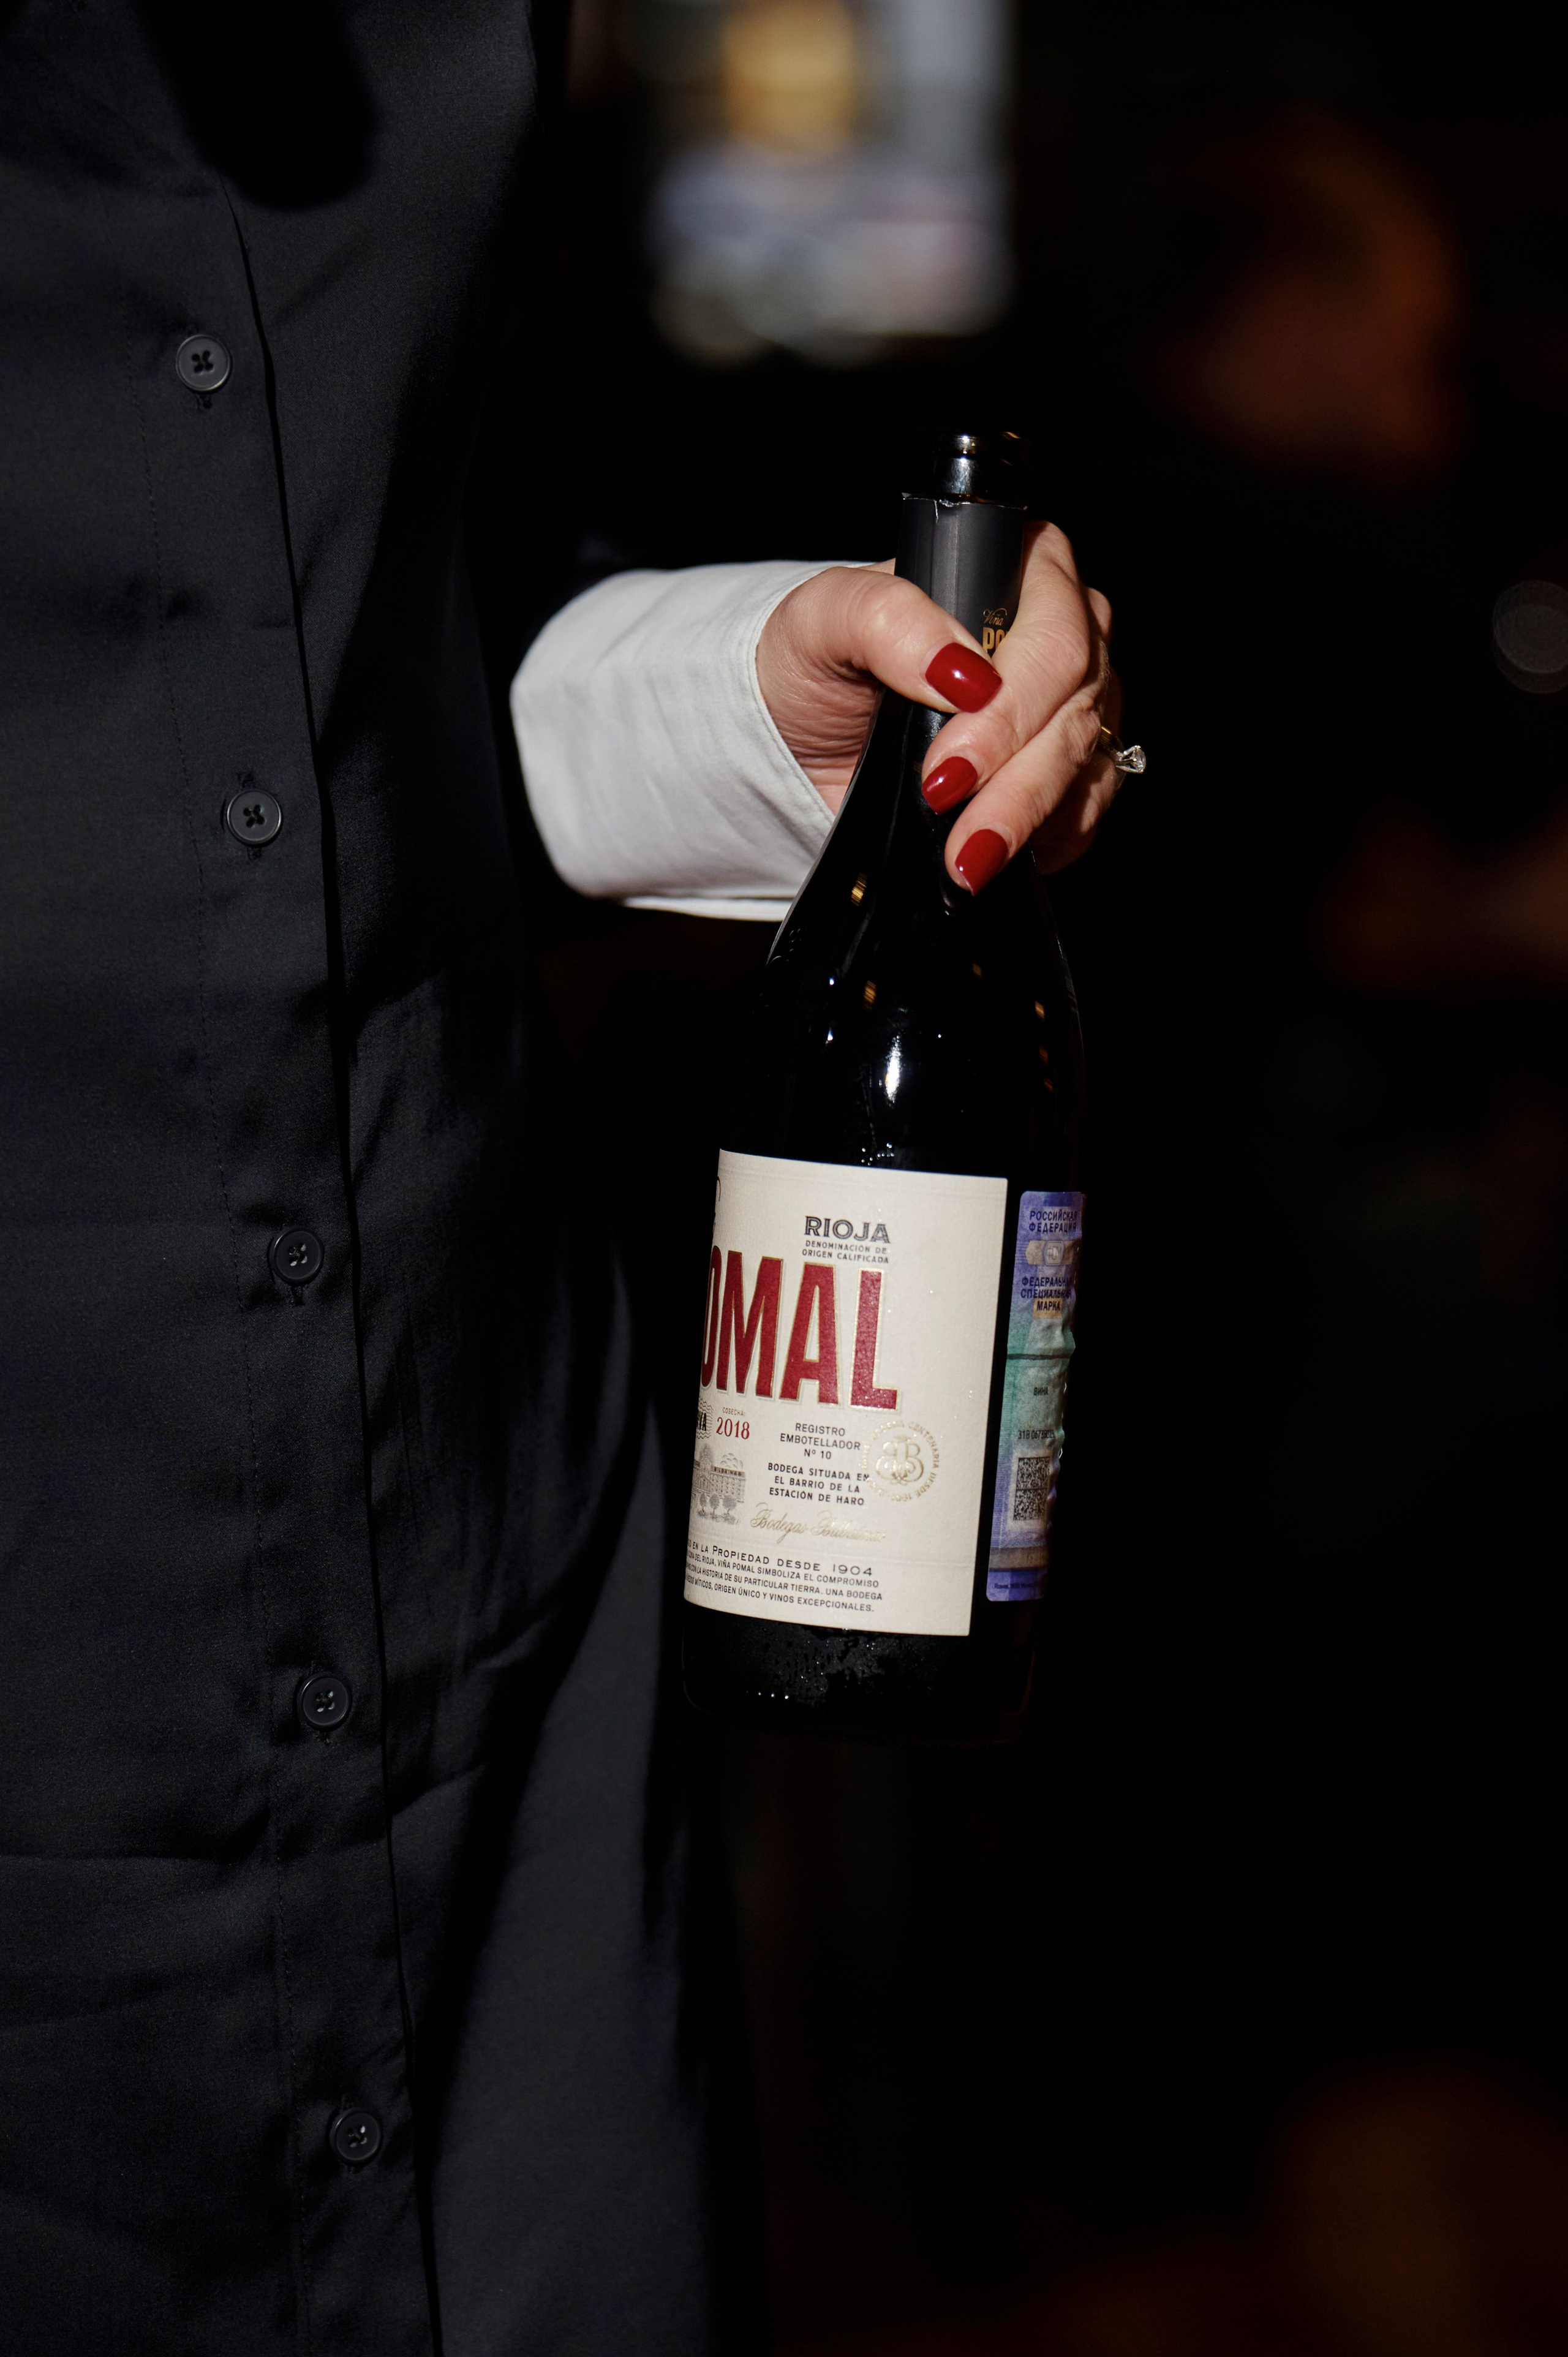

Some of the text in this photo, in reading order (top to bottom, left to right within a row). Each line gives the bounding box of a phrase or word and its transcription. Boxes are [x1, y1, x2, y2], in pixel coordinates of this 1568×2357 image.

[982, 627, 1008, 653] PO
[1030, 1209, 1077, 1221] РОССИЙСКАЯ
[804, 1216, 891, 1243] RIOJA
[1029, 1222, 1076, 1234] ФЕДЕРАЦИЯ
[802, 1249, 889, 1263] ORIGEN CALIFICADA
[1036, 1301, 1060, 1311] МАРКА
[716, 1417, 750, 1439] 2018
[796, 1423, 845, 1436] REGISTRO
[1018, 1430, 1030, 1439] 318
[780, 1433, 861, 1450] EMBOTELLADOR
[768, 1463, 804, 1474] BODEGA
[809, 1468, 850, 1480] SITUADA
[775, 1476, 784, 1485] EL
[790, 1478, 824, 1489] BARRIO
[769, 1487, 813, 1500] ESTACIÓN
[837, 1496, 864, 1506] HARO
[750, 1503, 807, 1544] Bodegas
[693, 1541, 698, 1550] EN
[701, 1544, 709, 1553] LA
[712, 1545, 769, 1564] PROPIEDAD
[777, 1558, 820, 1571] DESDE
[833, 1564, 872, 1576] 1904
[702, 1556, 717, 1567] RIOJA,
[718, 1559, 731, 1569] VIÑA
[733, 1563, 755, 1573] POMAL
[757, 1567, 801, 1580] SIMBOLIZA
[816, 1575, 879, 1588] COMPROMISO
[702, 1568, 723, 1579] HISTORIA
[744, 1577, 788, 1590] PARTICULAR
[791, 1584, 823, 1594] TIERRA.
[826, 1588, 843, 1597] UNA
[846, 1591, 882, 1601] BODEGA
[695, 1578, 713, 1590] MÍTICOS,
[714, 1583, 736, 1594] ORIGEN
[738, 1586, 760, 1598] ÚNICO
[769, 1593, 794, 1603] VINOS
[797, 1597, 874, 1612] EXCEPCIONALES.
